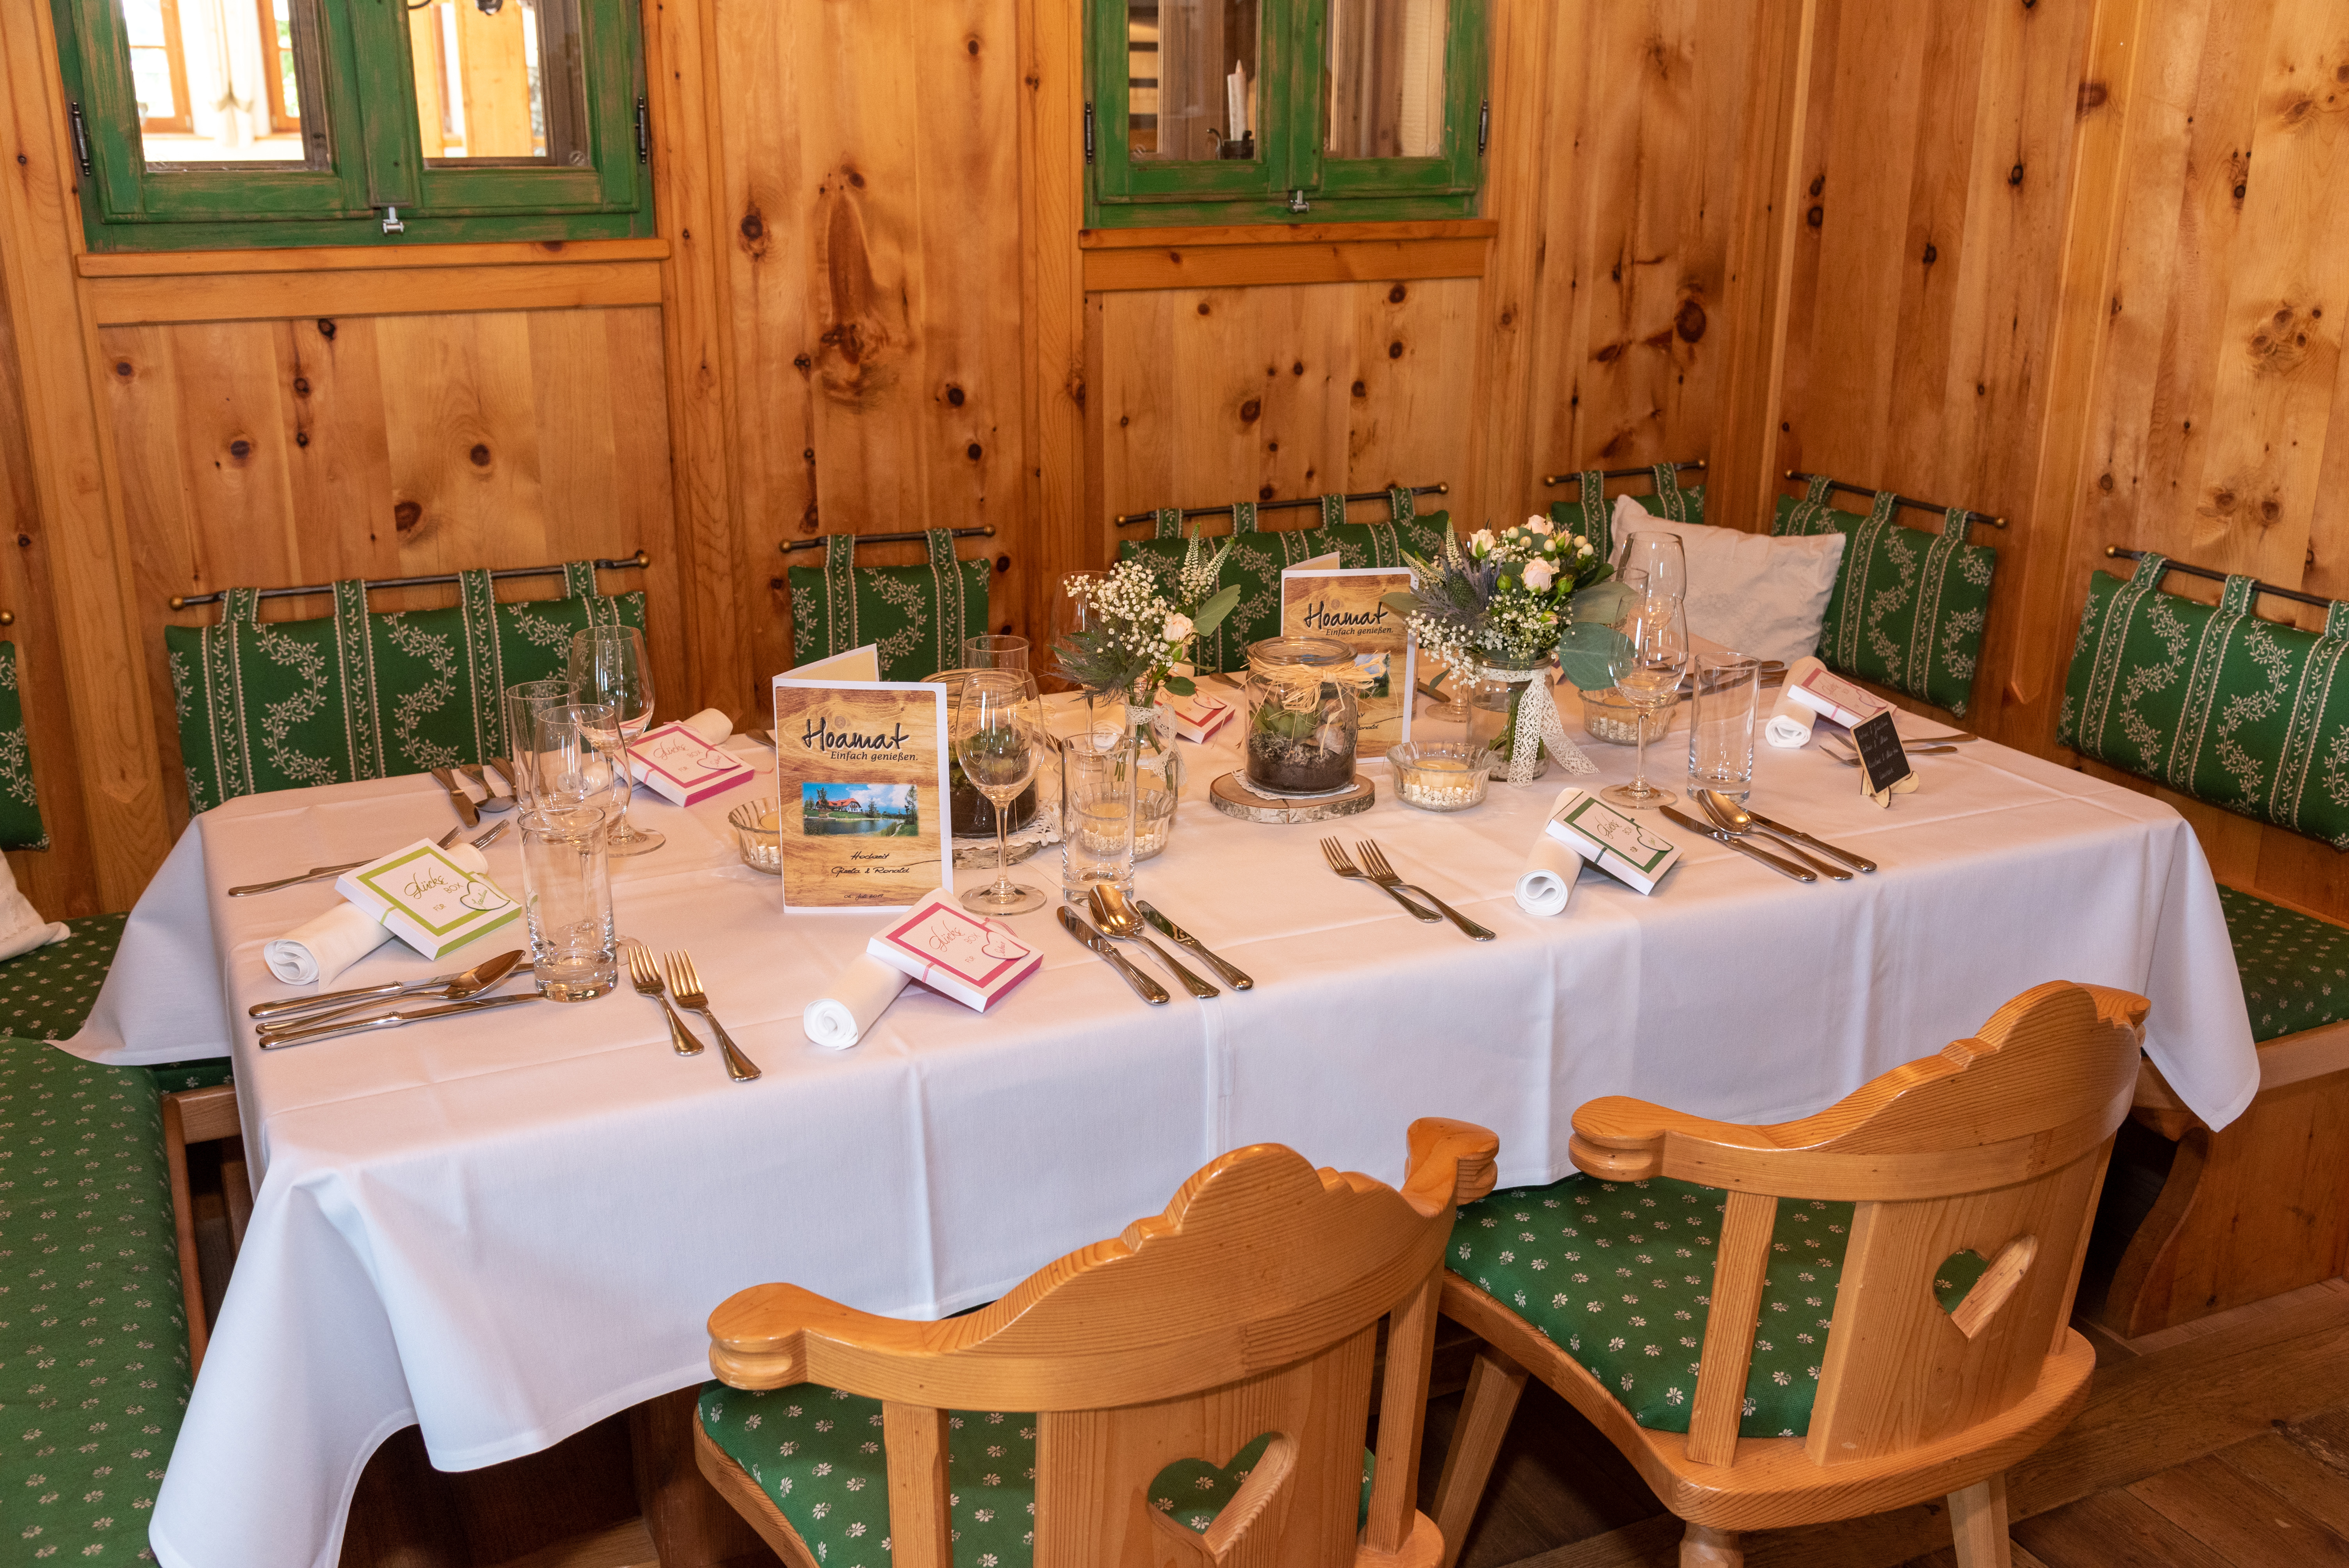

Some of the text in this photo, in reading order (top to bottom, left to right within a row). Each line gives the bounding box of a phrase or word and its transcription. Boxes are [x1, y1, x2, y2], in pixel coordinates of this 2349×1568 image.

[1303, 600, 1388, 629] Hoamat
[1326, 627, 1394, 636] Einfach genießen.
[802, 717, 910, 751] Hoamat
[654, 738, 689, 760] Glücks
[687, 750, 702, 758] BOX
[831, 751, 919, 762] Einfach genießen.
[1595, 813, 1622, 839] Glücks
[1622, 826, 1634, 835] BOX
[850, 851, 890, 860] Hochzeit
[831, 867, 861, 877] Gisela
[405, 868, 447, 899] Glücks
[443, 882, 464, 894] BOX
[855, 893, 867, 901] Juli
[929, 920, 965, 952] Glücks
[964, 932, 980, 944] BOX
